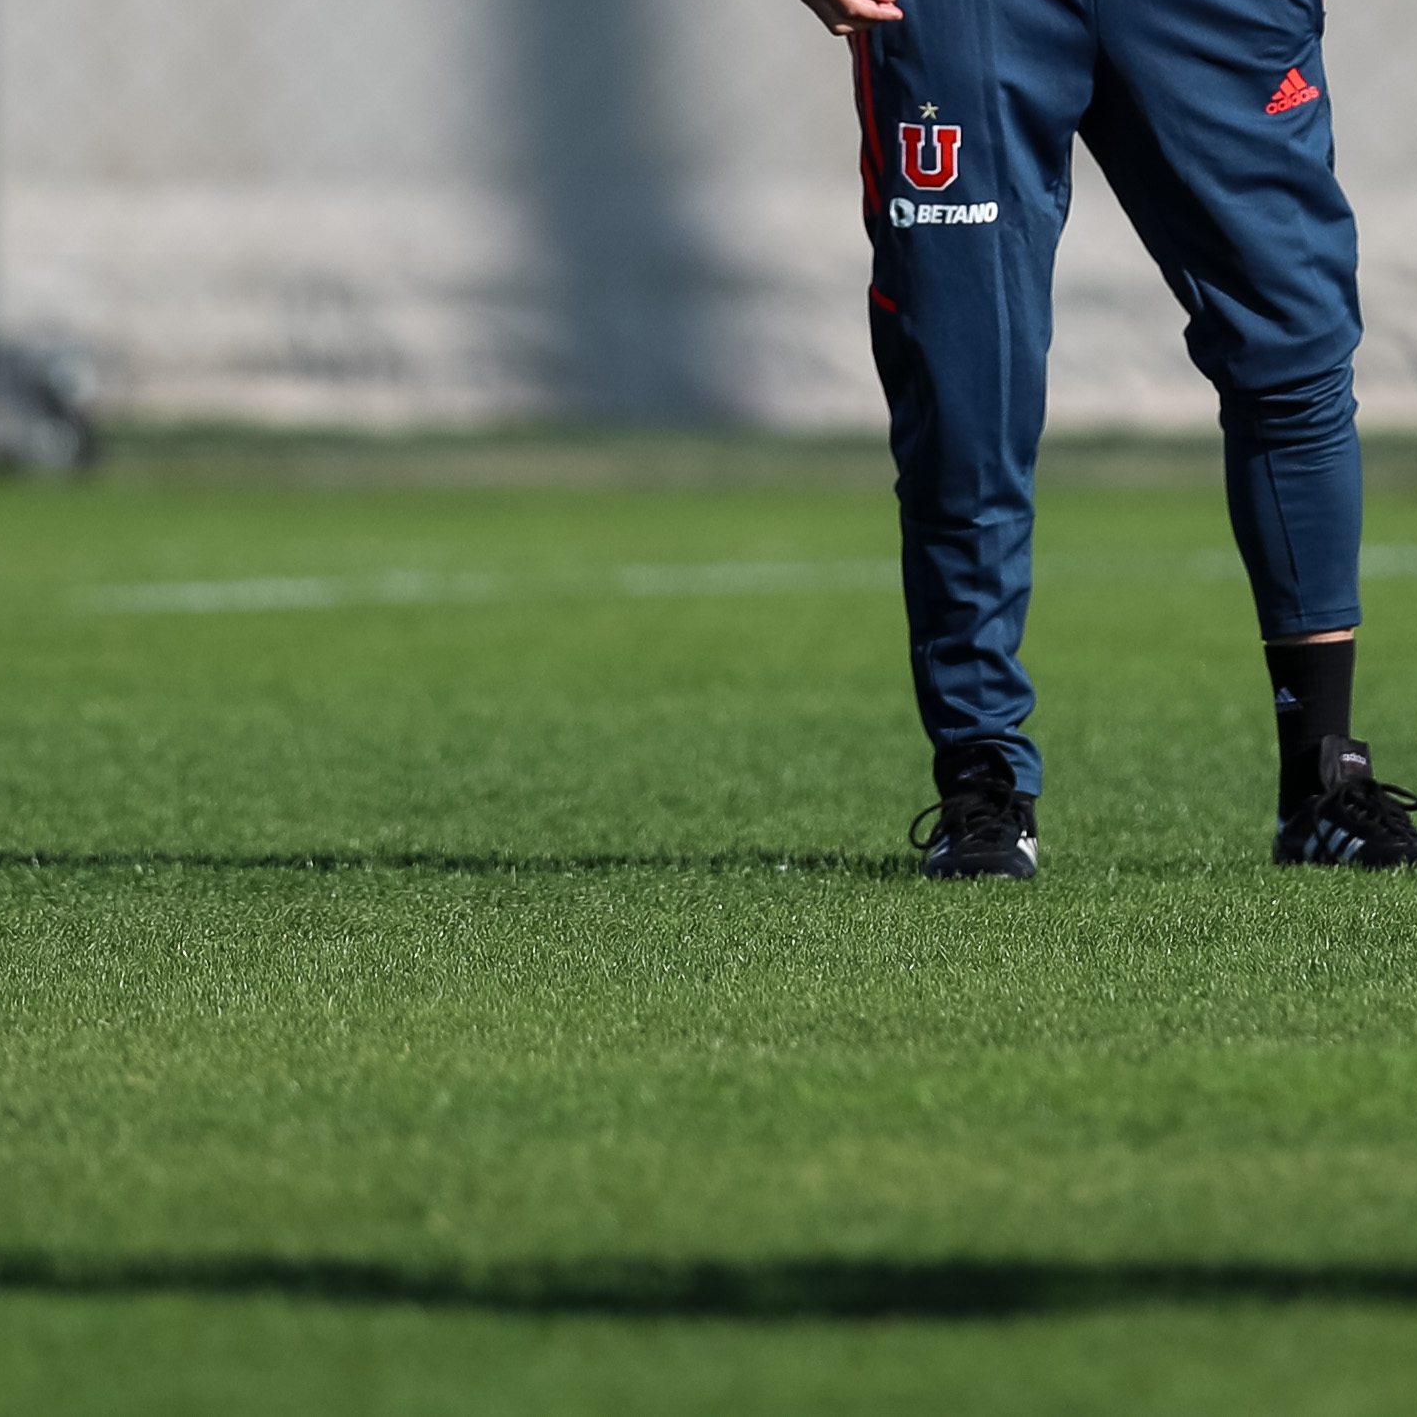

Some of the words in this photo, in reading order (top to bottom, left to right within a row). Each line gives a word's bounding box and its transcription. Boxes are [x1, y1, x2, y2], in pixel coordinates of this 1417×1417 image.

[1265, 85, 1321, 115] adidas
[898, 122, 962, 191] U
[916, 201, 999, 225] BETANO
